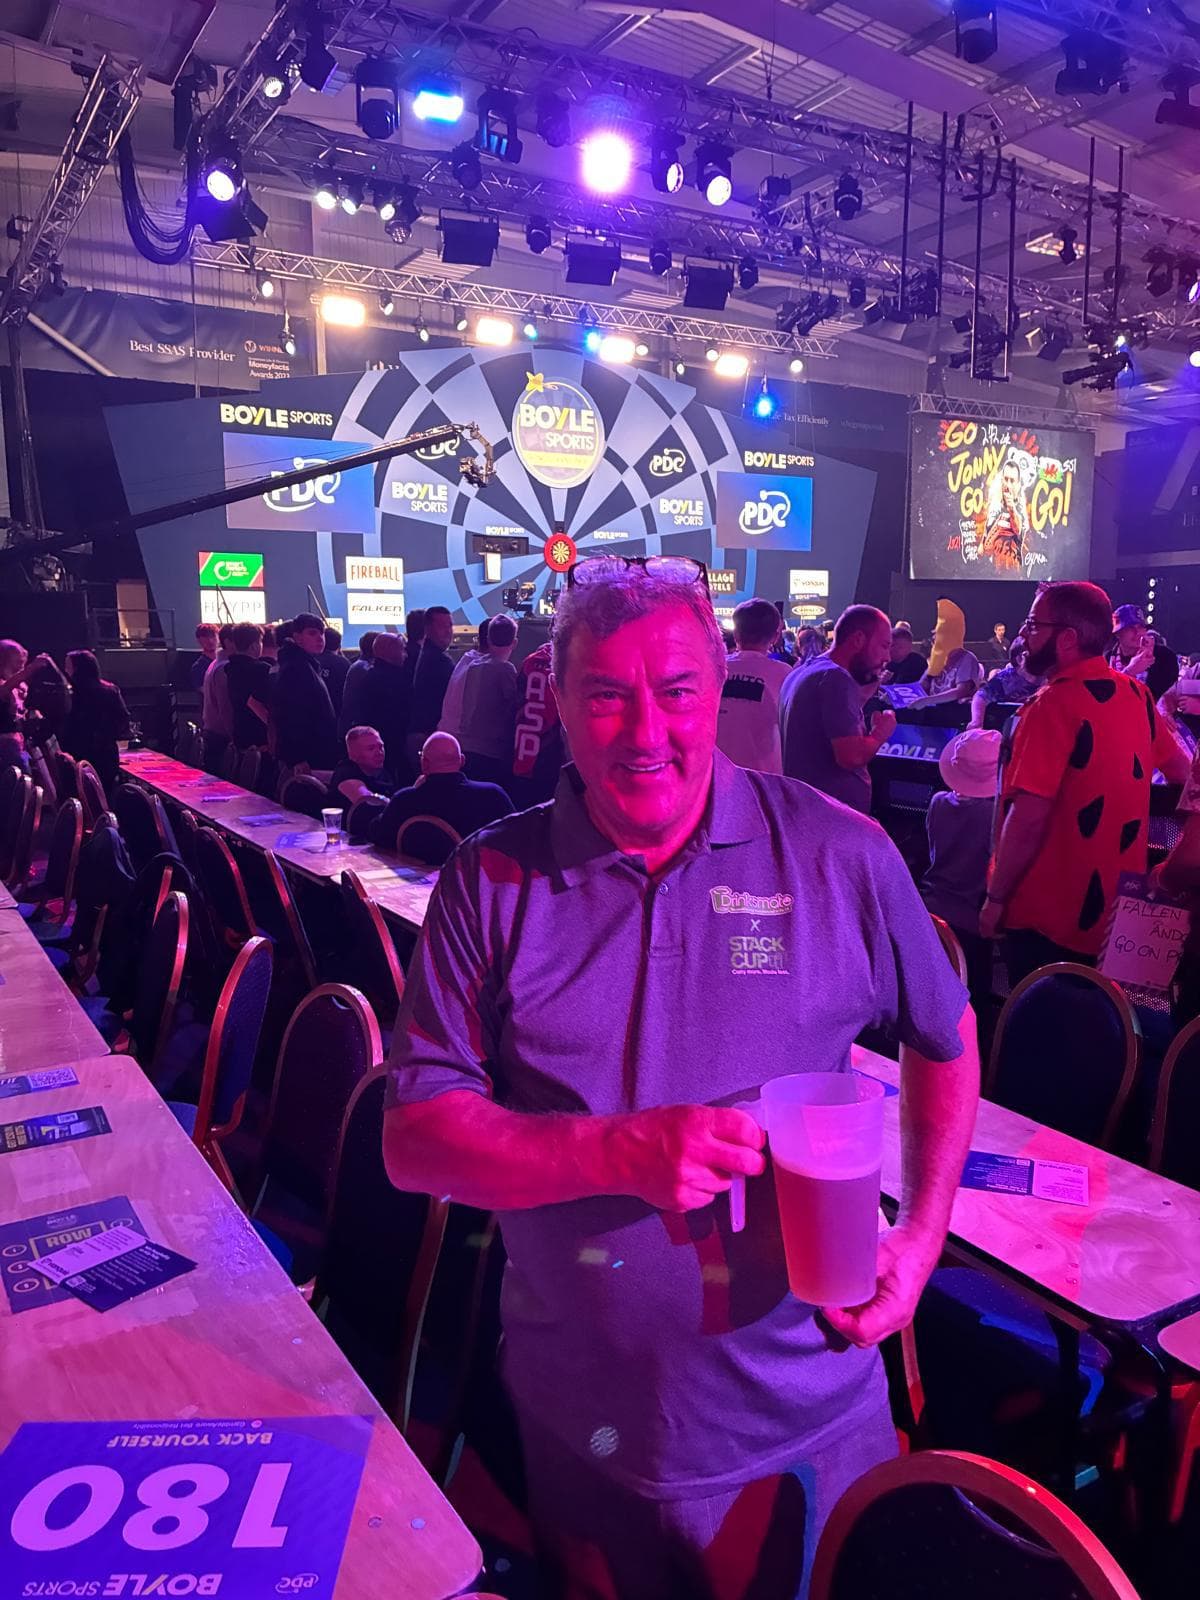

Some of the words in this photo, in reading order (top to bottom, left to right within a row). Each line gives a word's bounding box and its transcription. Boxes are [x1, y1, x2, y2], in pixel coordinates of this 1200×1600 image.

[129, 339, 153, 353] Best
[157, 343, 186, 356] SSAS
[189, 347, 236, 362] Provider
[248, 360, 290, 372] Moneyfacts
[220, 403, 289, 428] BOYLE
[289, 410, 333, 426] SPORTS
[519, 403, 595, 433] BOYLE
[545, 432, 595, 450] SPORTS
[944, 420, 978, 448] GO
[651, 452, 685, 475] PDC
[743, 450, 787, 469] BOYLE
[787, 455, 815, 467] SPORTS
[947, 444, 1006, 493] JONNY
[392, 481, 448, 501] BOYLE
[411, 501, 448, 513] SPORTS
[660, 498, 704, 516] BOYLE
[1031, 472, 1073, 531] GO!
[673, 515, 704, 526] SPORTS
[742, 497, 788, 531] PDC
[351, 565, 400, 582] FIREBALL
[707, 572, 734, 583] LLAGE
[709, 582, 731, 591] OTELS
[879, 742, 937, 759] BOYLE
[717, 891, 793, 910] Drinksmate
[1122, 900, 1182, 921] FALLEN
[729, 936, 785, 952] STACK
[1114, 935, 1136, 954] GO
[46, 1228, 92, 1248] ROW
[106, 1434, 210, 1448] YOURSELF
[217, 1432, 273, 1445] BACK
[10, 1462, 292, 1552] 180
[22, 1580, 101, 1596] SPORTS
[102, 1573, 223, 1596] BOYLE
[277, 1574, 317, 1591] PDC
